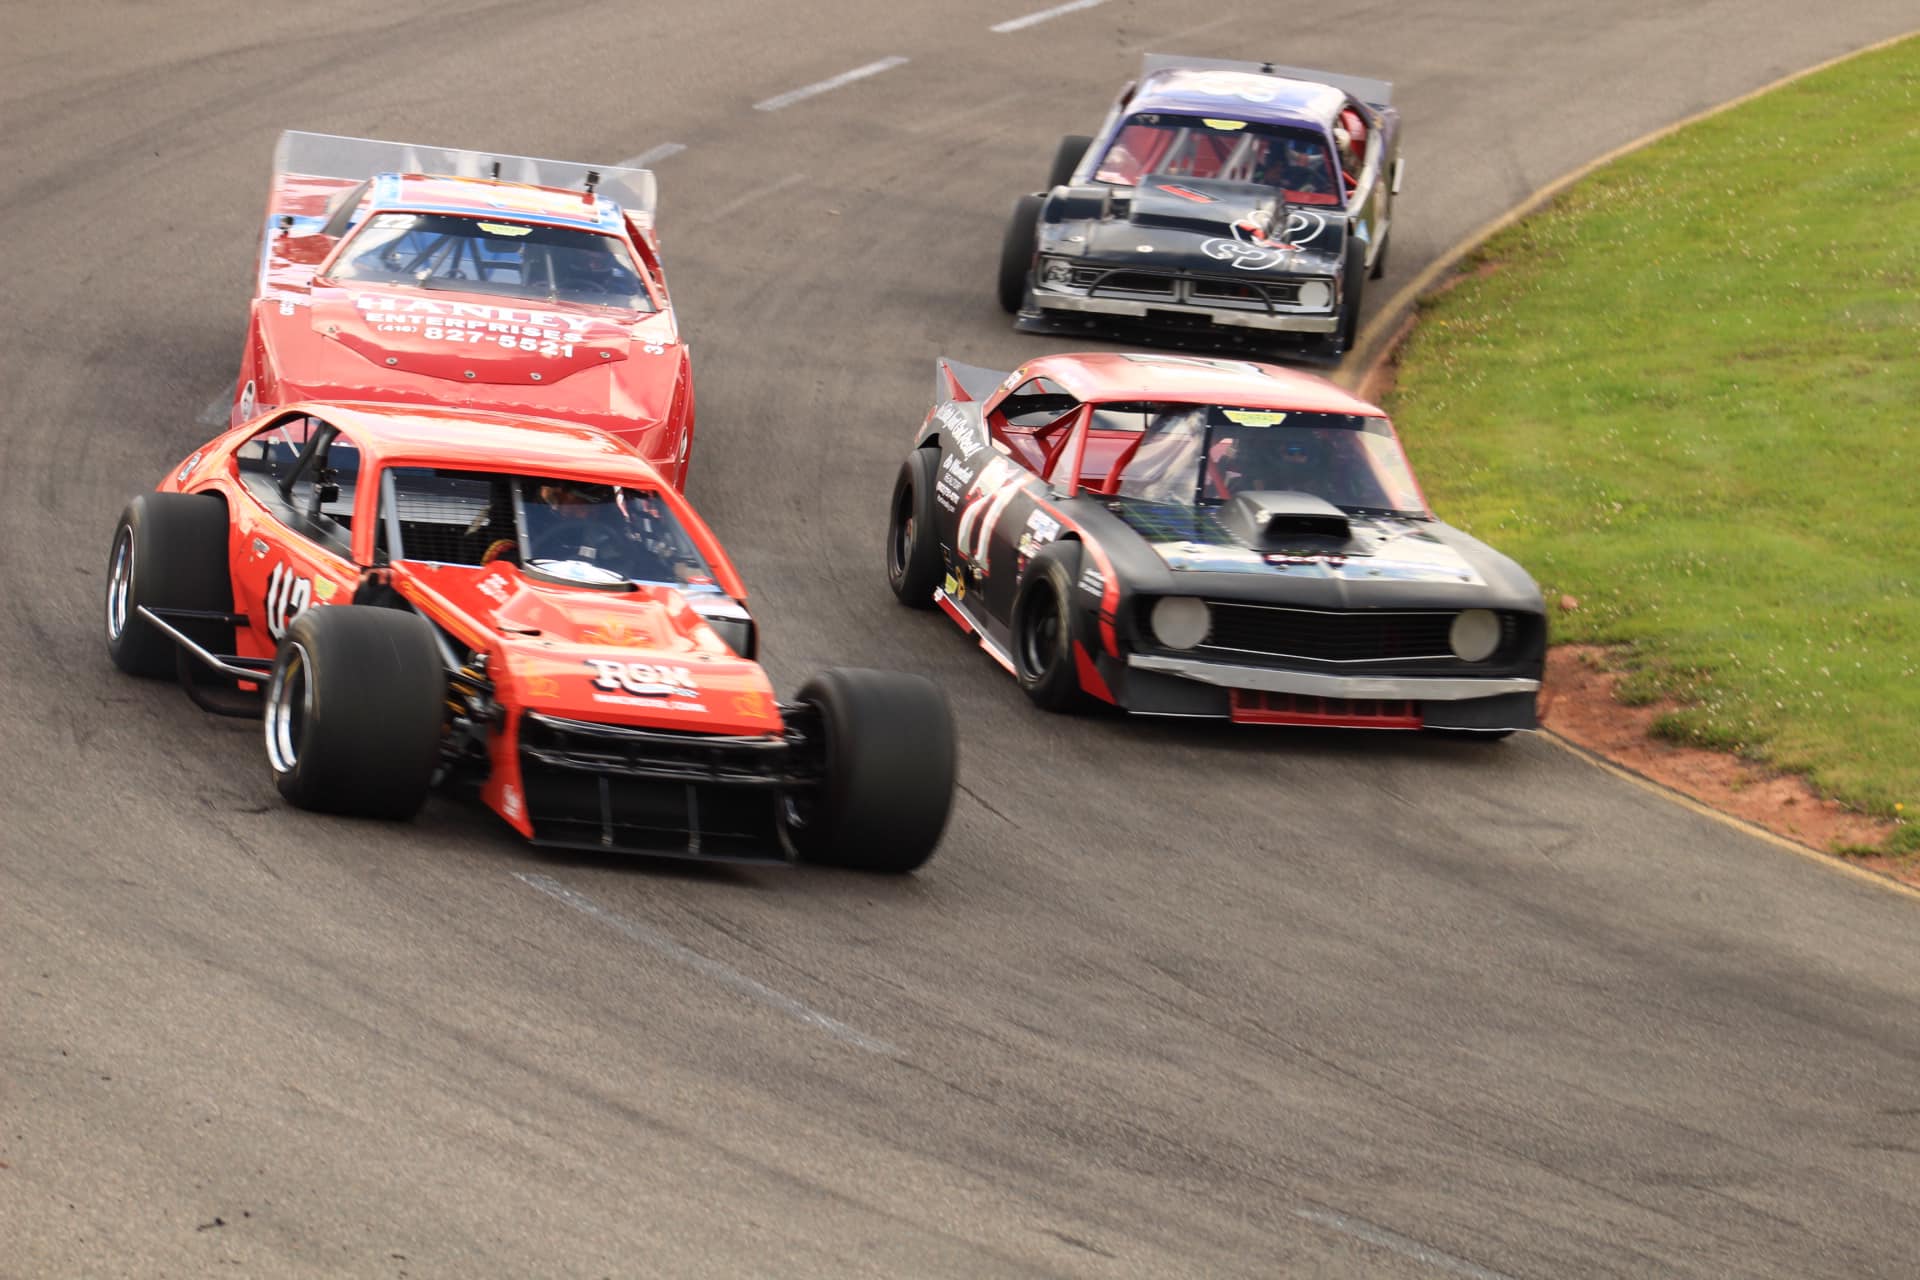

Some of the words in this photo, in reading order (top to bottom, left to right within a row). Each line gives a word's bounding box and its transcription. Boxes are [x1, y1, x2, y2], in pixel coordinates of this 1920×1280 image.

[357, 297, 592, 331] HANLEY
[366, 313, 583, 343] ENTERPRISES
[423, 328, 575, 358] 827-5521
